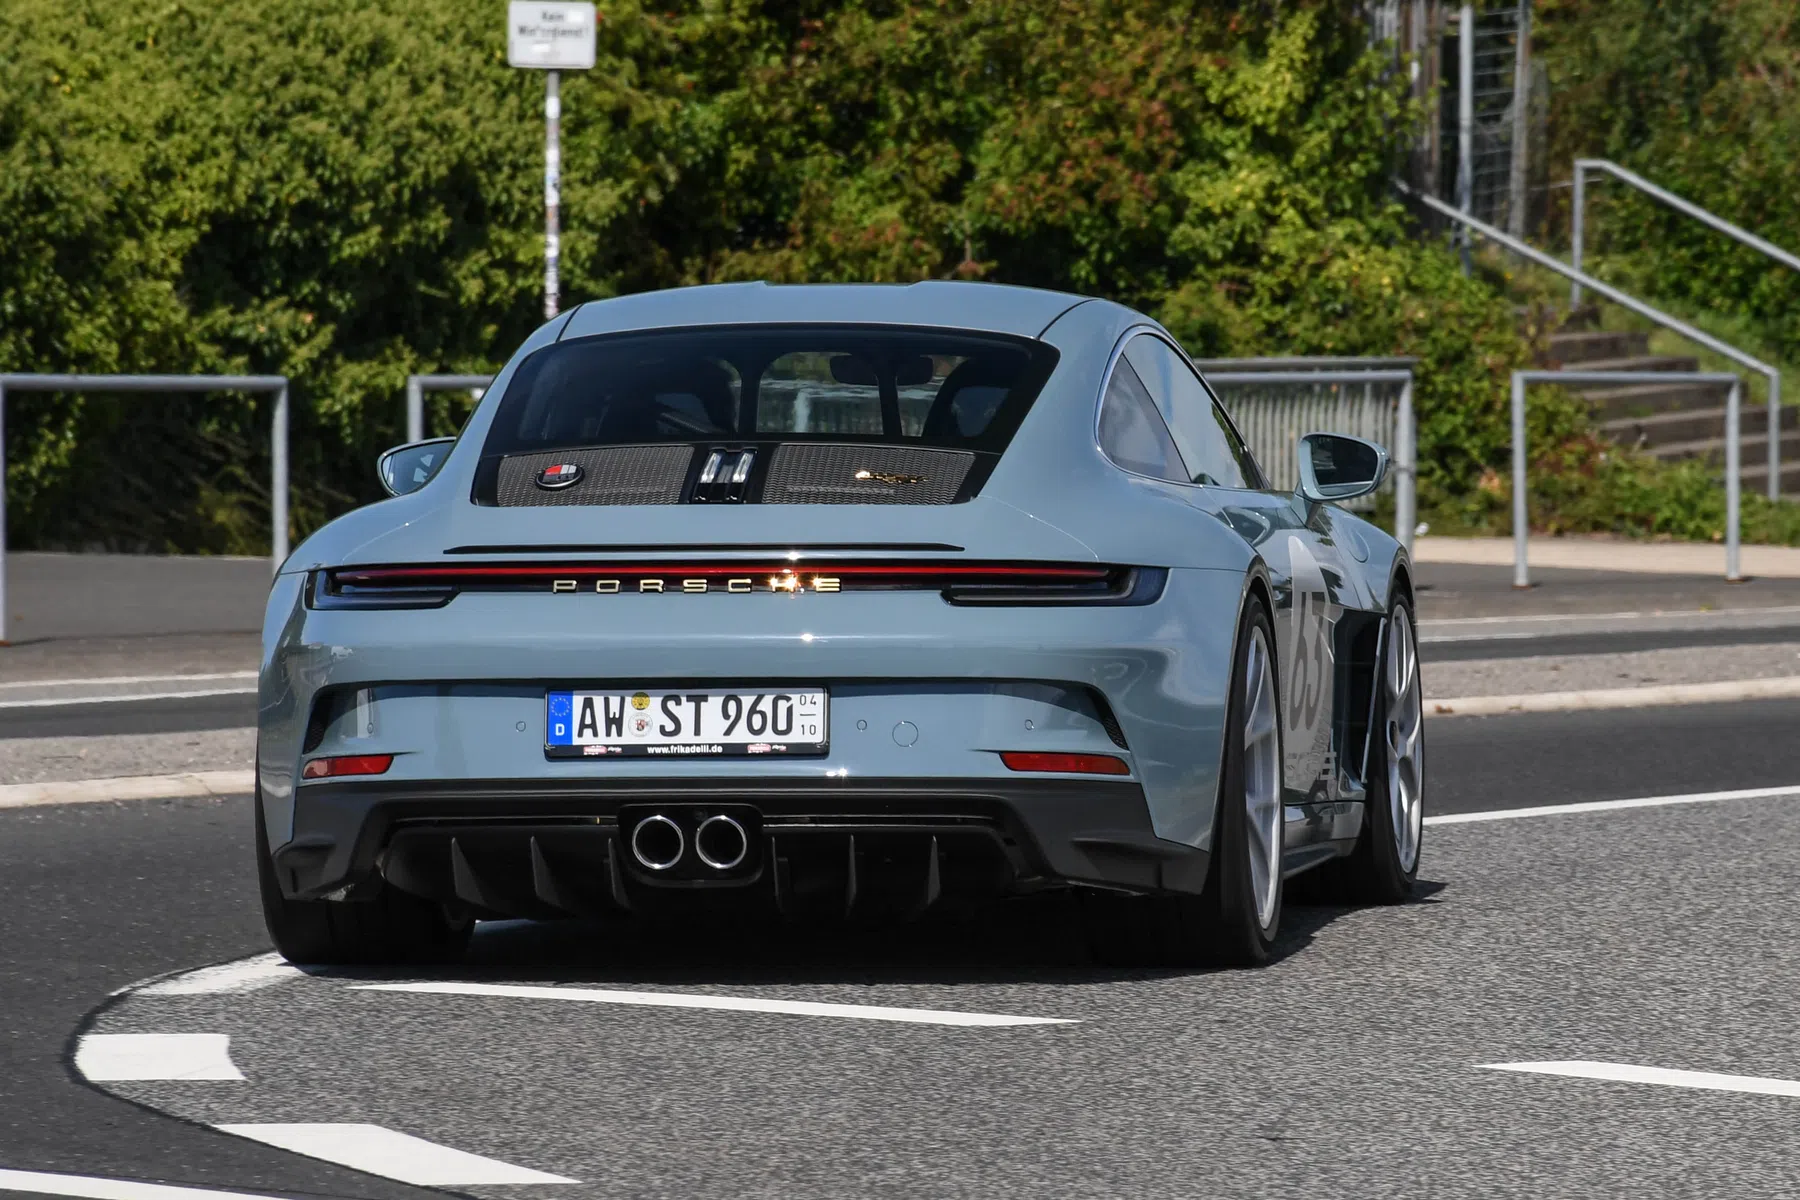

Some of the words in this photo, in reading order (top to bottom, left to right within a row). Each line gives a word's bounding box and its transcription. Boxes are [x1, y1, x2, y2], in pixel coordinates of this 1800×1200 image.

[552, 578, 841, 594] PORSCHE
[799, 694, 817, 707] 04
[577, 695, 626, 739] AW
[658, 694, 709, 738] ST
[721, 693, 795, 737] 960
[555, 724, 565, 737] D
[800, 724, 817, 737] 10
[647, 744, 723, 754] www.frikadelli.de
